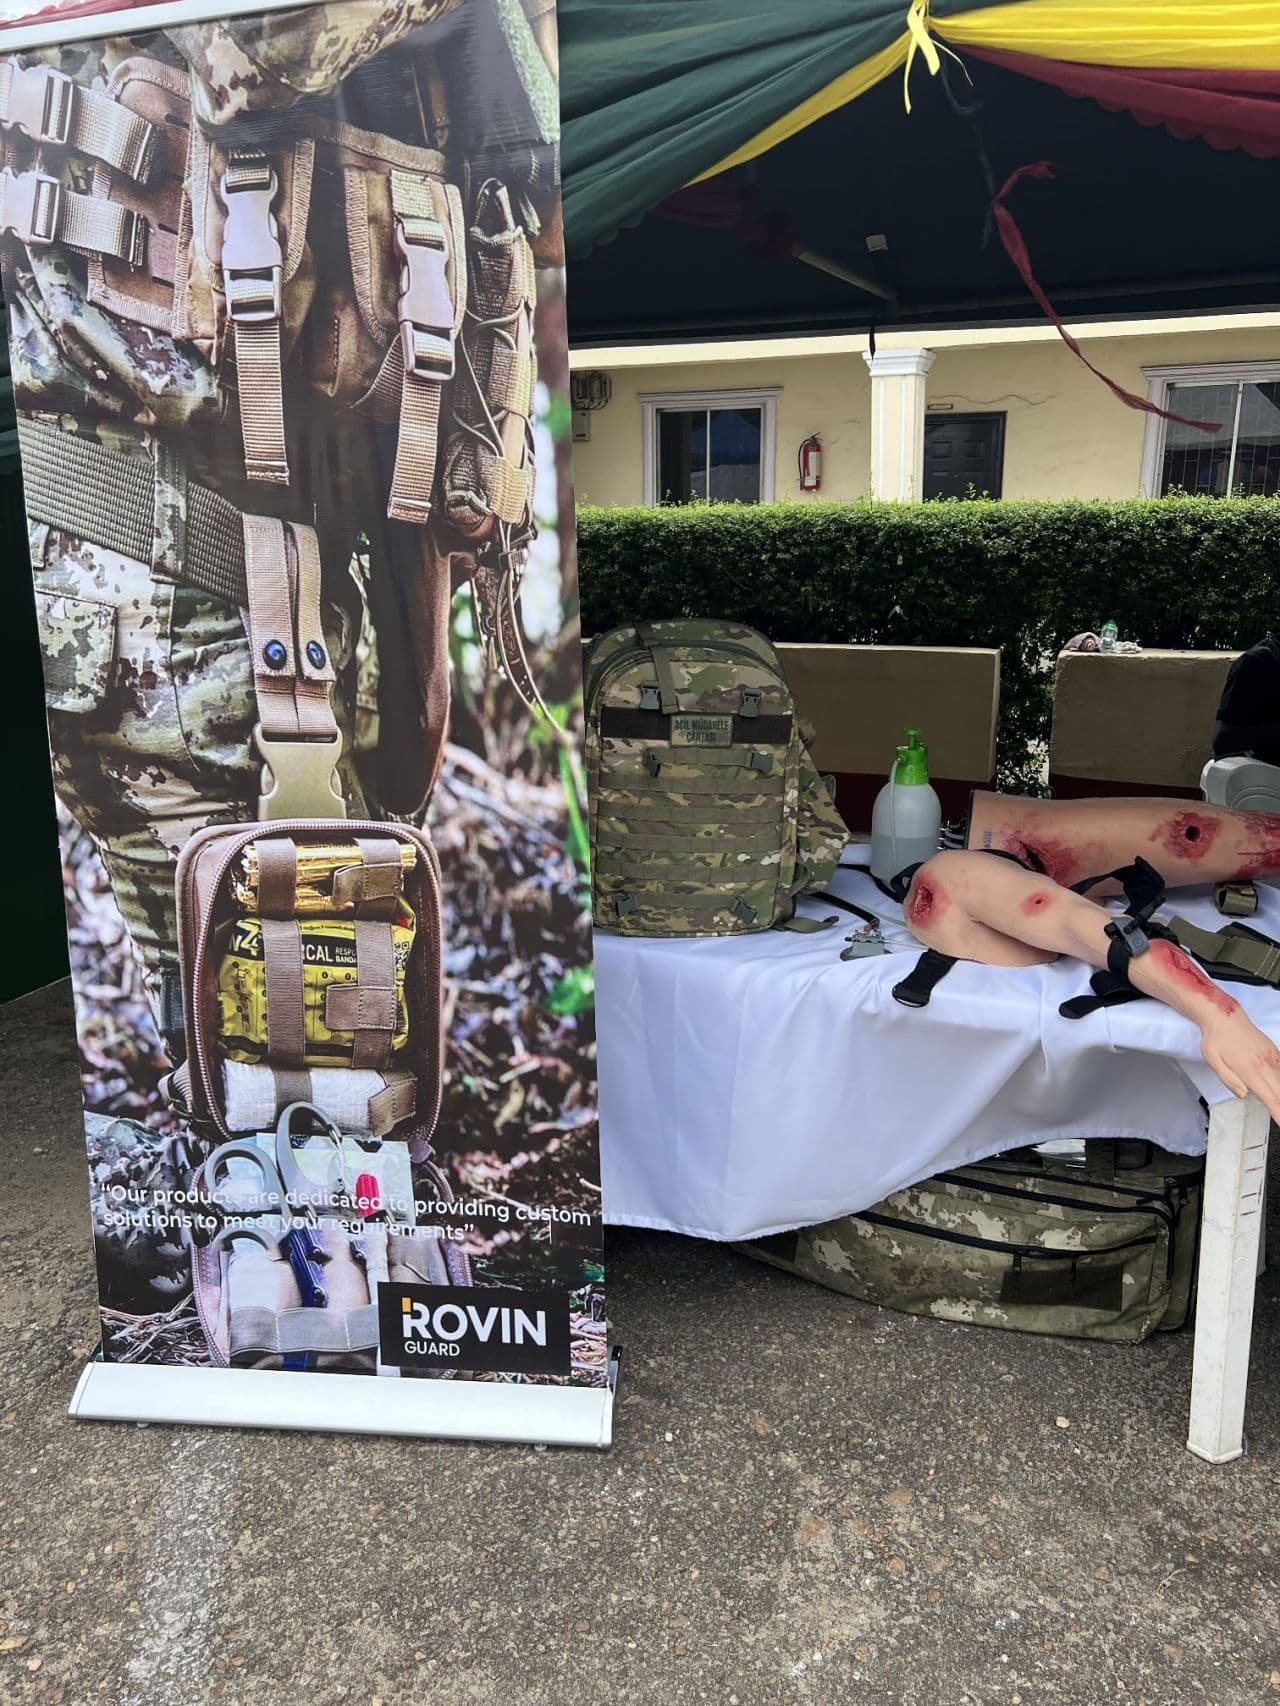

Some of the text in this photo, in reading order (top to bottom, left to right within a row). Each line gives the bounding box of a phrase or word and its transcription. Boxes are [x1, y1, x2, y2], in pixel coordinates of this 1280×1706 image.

[153, 1187, 242, 1207] products
[248, 1190, 280, 1204] are
[285, 1187, 382, 1210] dedicated
[390, 1197, 409, 1211] to
[415, 1198, 510, 1221] providing
[515, 1206, 592, 1226] custom
[104, 1211, 193, 1229] solutions
[198, 1213, 218, 1229] to
[223, 1214, 276, 1230] meet
[281, 1216, 322, 1234] your
[402, 1297, 547, 1346] ROVIN
[404, 1341, 460, 1357] GUARD
